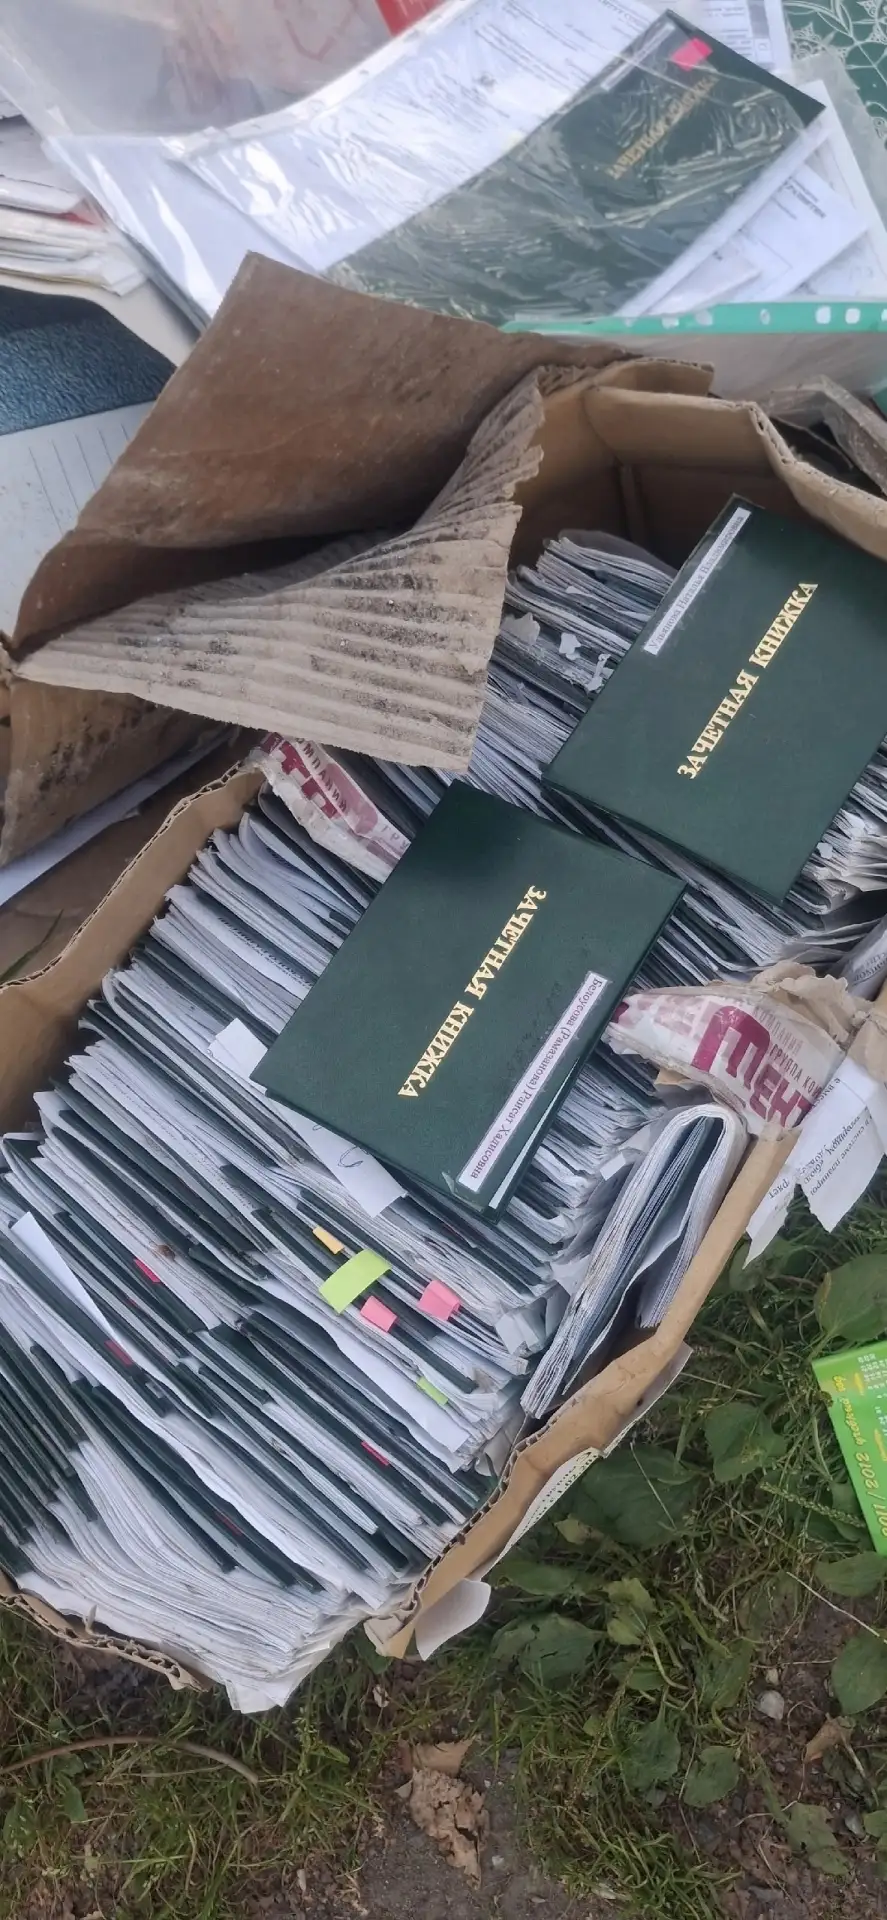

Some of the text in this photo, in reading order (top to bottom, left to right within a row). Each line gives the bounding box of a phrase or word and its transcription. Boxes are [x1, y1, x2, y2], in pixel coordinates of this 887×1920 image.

[675, 580, 819, 780] ЗАЧЕТНАЯ КНИЖКА
[396, 883, 548, 1098] ЗАЧЕТНАЯ КНИЖКА
[564, 976, 603, 1027] Белоусова
[524, 1025, 572, 1091] (Рамазанова)
[768, 1043, 803, 1082] ГРУППА
[469, 1124, 511, 1180] Хадисовна
[838, 1125, 866, 1160] системе
